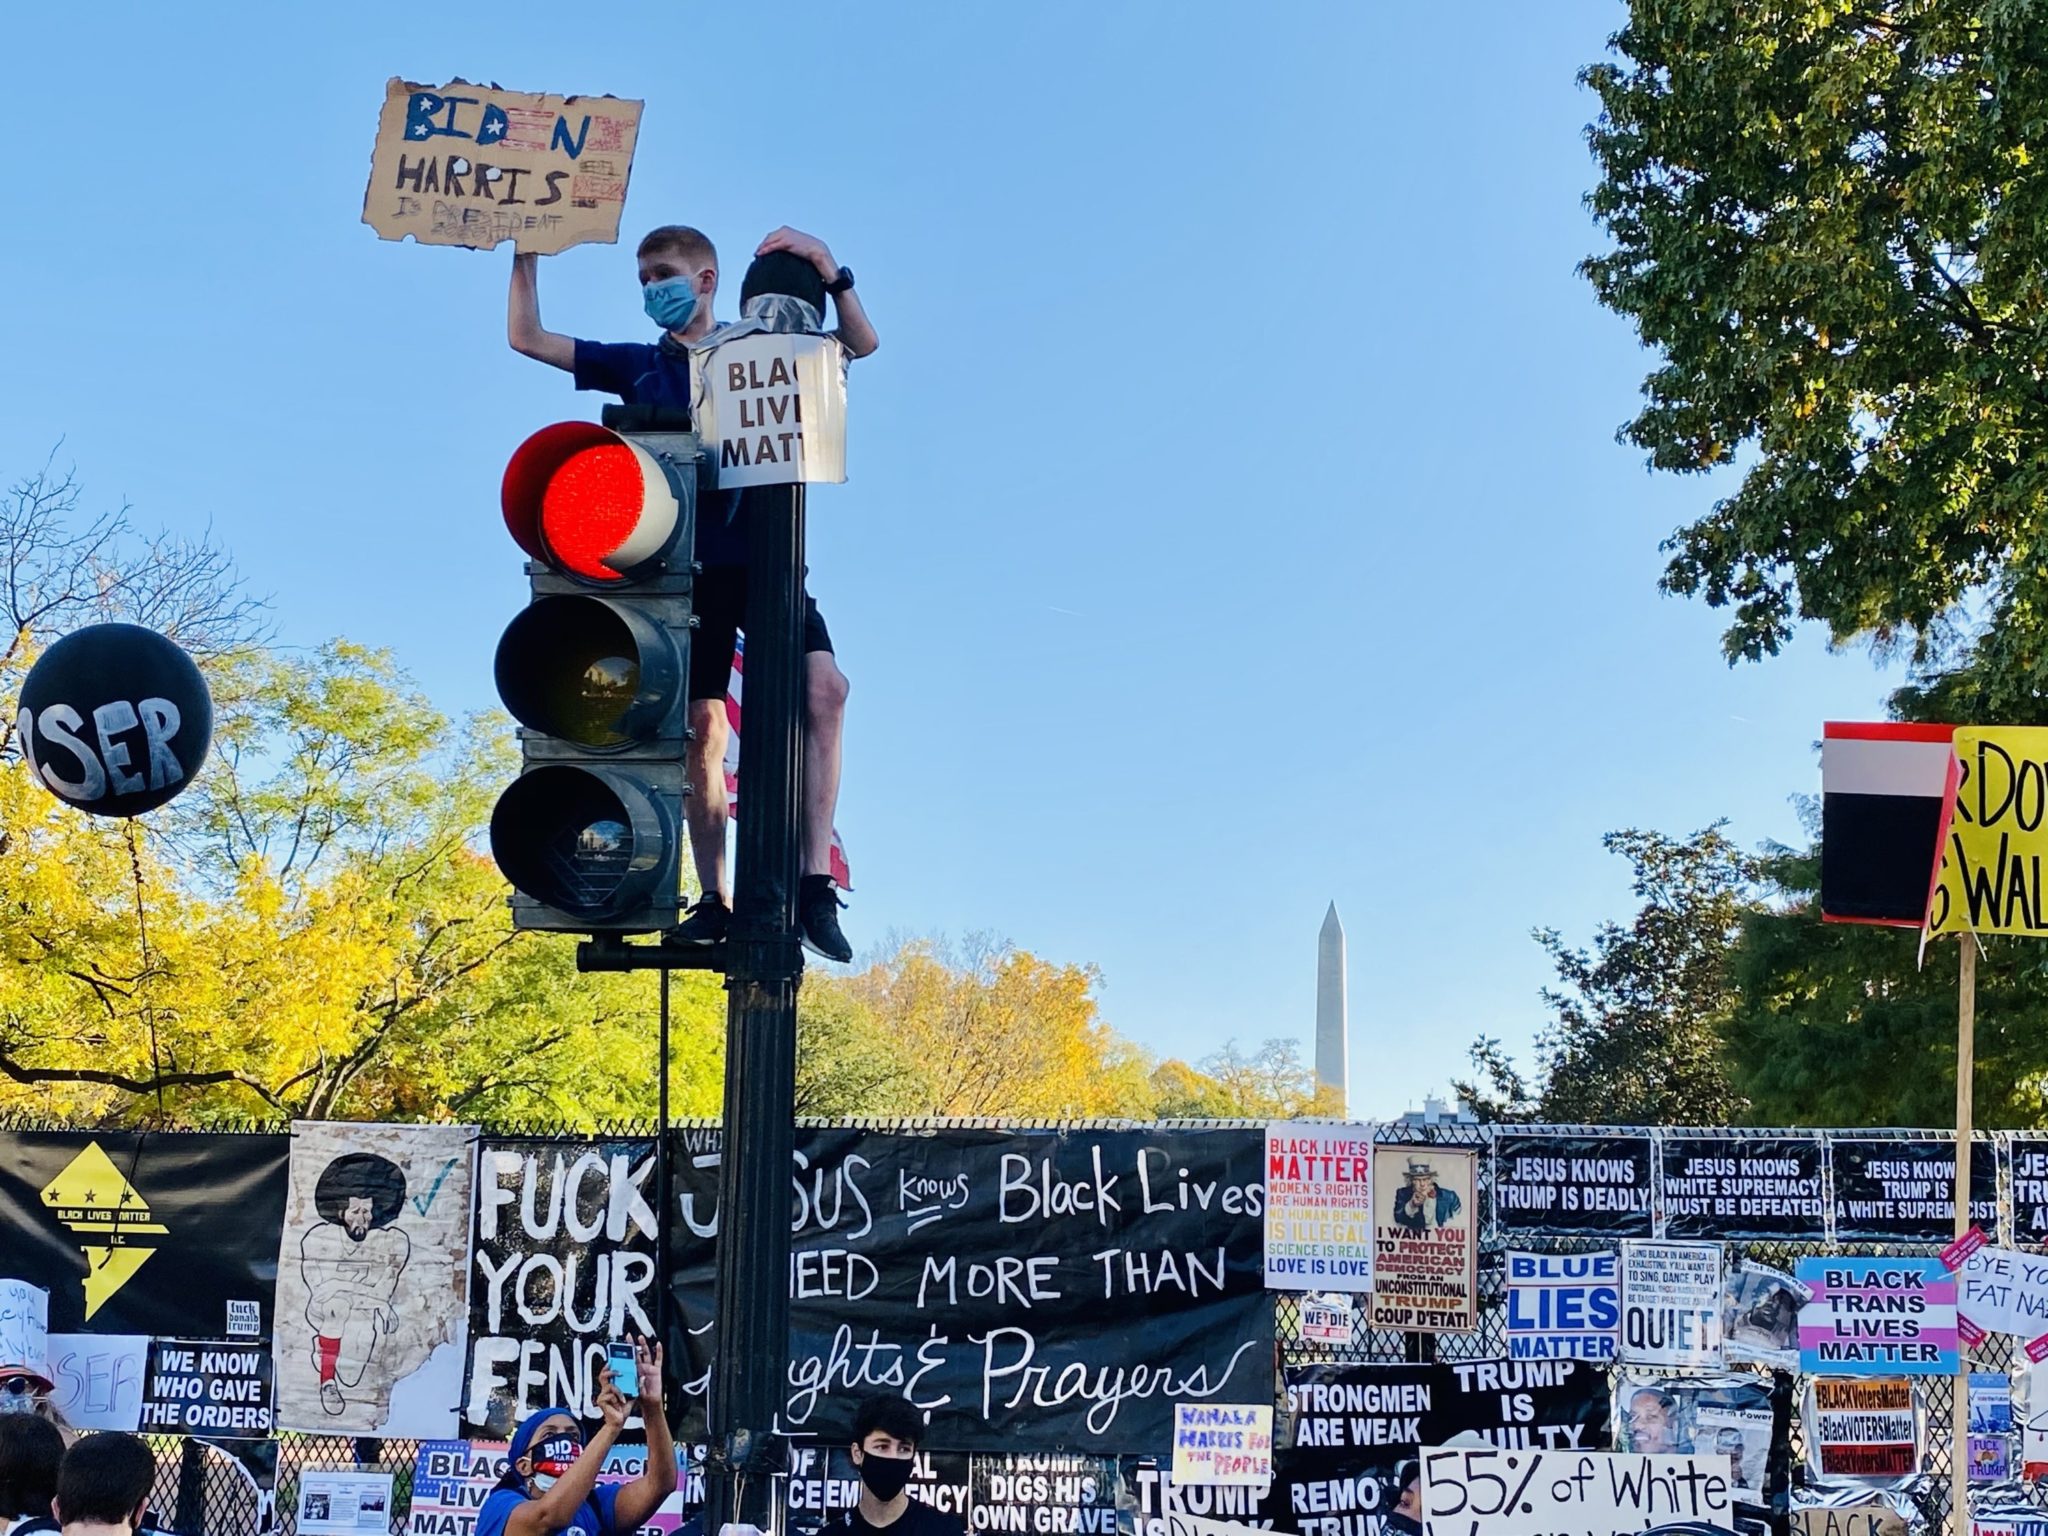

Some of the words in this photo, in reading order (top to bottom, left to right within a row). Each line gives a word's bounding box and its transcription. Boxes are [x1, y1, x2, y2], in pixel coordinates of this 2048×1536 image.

[404, 92, 592, 160] BIDEN
[396, 153, 570, 206] HARRIS
[1269, 1139, 1318, 1155] BLACK
[1324, 1140, 1368, 1156] LIVES
[1269, 1156, 1368, 1183] MATTER
[1512, 1157, 1566, 1181] JESUS
[1571, 1158, 1635, 1183] KNOWS
[1684, 1158, 1736, 1175] JESUS
[1740, 1159, 1800, 1176] KNOWS
[1864, 1161, 1909, 1179] JESUS
[1913, 1161, 1957, 1179] KNOW
[2020, 1154, 2048, 1177] JE
[480, 1147, 659, 1243] FUCK
[999, 1145, 1121, 1227] Black
[1142, 1149, 1265, 1217] Lives
[1269, 1182, 1322, 1195] WOMEN'S
[1325, 1183, 1368, 1197] RIGHTS
[1665, 1178, 1717, 1195] WHITE
[1721, 1178, 1820, 1197] SUPREMACY
[1882, 1181, 1931, 1199] TRUMP
[1934, 1182, 1949, 1199] IS
[1269, 1195, 1291, 1206] ARE
[1293, 1196, 1327, 1208] HUMAN
[1330, 1197, 1368, 1209] RIGHTS
[1497, 1184, 1556, 1210] TRUMP
[1562, 1186, 1579, 1211] IS
[1586, 1187, 1650, 1212] DEADLY
[1665, 1198, 1710, 1216] MUST
[1715, 1199, 1736, 1216] BE
[1740, 1199, 1824, 1216] DEFEATED
[57, 1210, 83, 1220] BLACK
[87, 1210, 112, 1220] LIVES
[1269, 1208, 1284, 1220] NO
[1288, 1209, 1328, 1221] HUMAN
[1332, 1210, 1368, 1223] BEING
[1836, 1202, 1846, 1218] A
[1849, 1201, 1894, 1218] WHITE
[1898, 1201, 1996, 1219] SUPREMCIST
[1269, 1222, 1285, 1240] IS
[1292, 1223, 1367, 1243] ILLEGAL
[1378, 1227, 1383, 1239] I
[1384, 1228, 1431, 1240] WANT
[1435, 1229, 1465, 1242] YOU
[1269, 1243, 1319, 1256] SCIENCE
[1323, 1245, 1334, 1257] IS
[1338, 1245, 1368, 1258] REAL
[1377, 1240, 1396, 1252] TO
[1399, 1241, 1465, 1256] PROTECT
[1648, 1250, 1669, 1259] BLACK
[1670, 1251, 1677, 1259] IN
[1678, 1251, 1707, 1260] AMERICA
[1269, 1258, 1306, 1273] LOVE
[1312, 1260, 1325, 1274] IS
[1330, 1260, 1369, 1276] LOVE
[1376, 1253, 1465, 1267] AMERICAN
[1376, 1264, 1464, 1276] DEMOCRACY
[1512, 1256, 1616, 1278] BLUE
[1687, 1263, 1705, 1271] WANT
[1706, 1263, 1715, 1272] US
[791, 1247, 879, 1300] EED
[917, 1255, 1062, 1309] MORE
[1092, 1246, 1227, 1300] THAN
[1628, 1270, 1639, 1281] TO
[1694, 1273, 1715, 1285] PLAY
[1825, 1270, 1924, 1290] BLACK
[476, 1249, 656, 1337] YOUR
[1375, 1279, 1467, 1298] UNCONSTITUTIONAL
[1966, 1280, 2012, 1308] FAT
[1379, 1295, 1463, 1310] TRUMP
[1508, 1287, 1619, 1330] LIES
[1825, 1295, 1926, 1313] TRANS
[1305, 1311, 1322, 1325] WE
[1330, 1313, 1349, 1327] DIE
[1375, 1308, 1413, 1325] COUP
[1627, 1306, 1719, 1351] QUIET.
[1835, 1319, 1920, 1338] LIVES
[1510, 1336, 1615, 1359] MATTER
[1819, 1343, 1940, 1362] MATTER
[162, 1350, 195, 1372] WE
[200, 1352, 260, 1375] KNOW
[466, 1336, 645, 1430] FENC
[968, 1327, 1257, 1435] Prayers
[1453, 1361, 1575, 1393] TRUMP
[153, 1375, 203, 1399] WHO
[209, 1379, 261, 1401] GAVE
[1287, 1384, 1431, 1413] STRONGMEN
[142, 1403, 181, 1425] THE
[185, 1405, 270, 1429] ORDERS
[1501, 1393, 1535, 1422] IS
[1739, 1411, 1773, 1421] Power
[1179, 1429, 1244, 1449] HARRIS
[1297, 1418, 1344, 1447] ARE
[1350, 1417, 1422, 1446] WEAK
[1482, 1423, 1586, 1450] UILTY
[1187, 1451, 1211, 1462] THE
[1214, 1452, 1269, 1476] PEOPLE
[1970, 1464, 2006, 1476] TRUMP
[991, 1475, 1051, 1502] DIGS
[1056, 1475, 1096, 1503] HIS
[1136, 1470, 1271, 1515] TRUMP
[1427, 1450, 1543, 1517] 55%
[1551, 1457, 1595, 1503] of
[1608, 1456, 1728, 1517] White
[1291, 1476, 1390, 1514] REMO
[973, 1504, 1028, 1533] OWN
[1034, 1505, 1116, 1534] GRAVE
